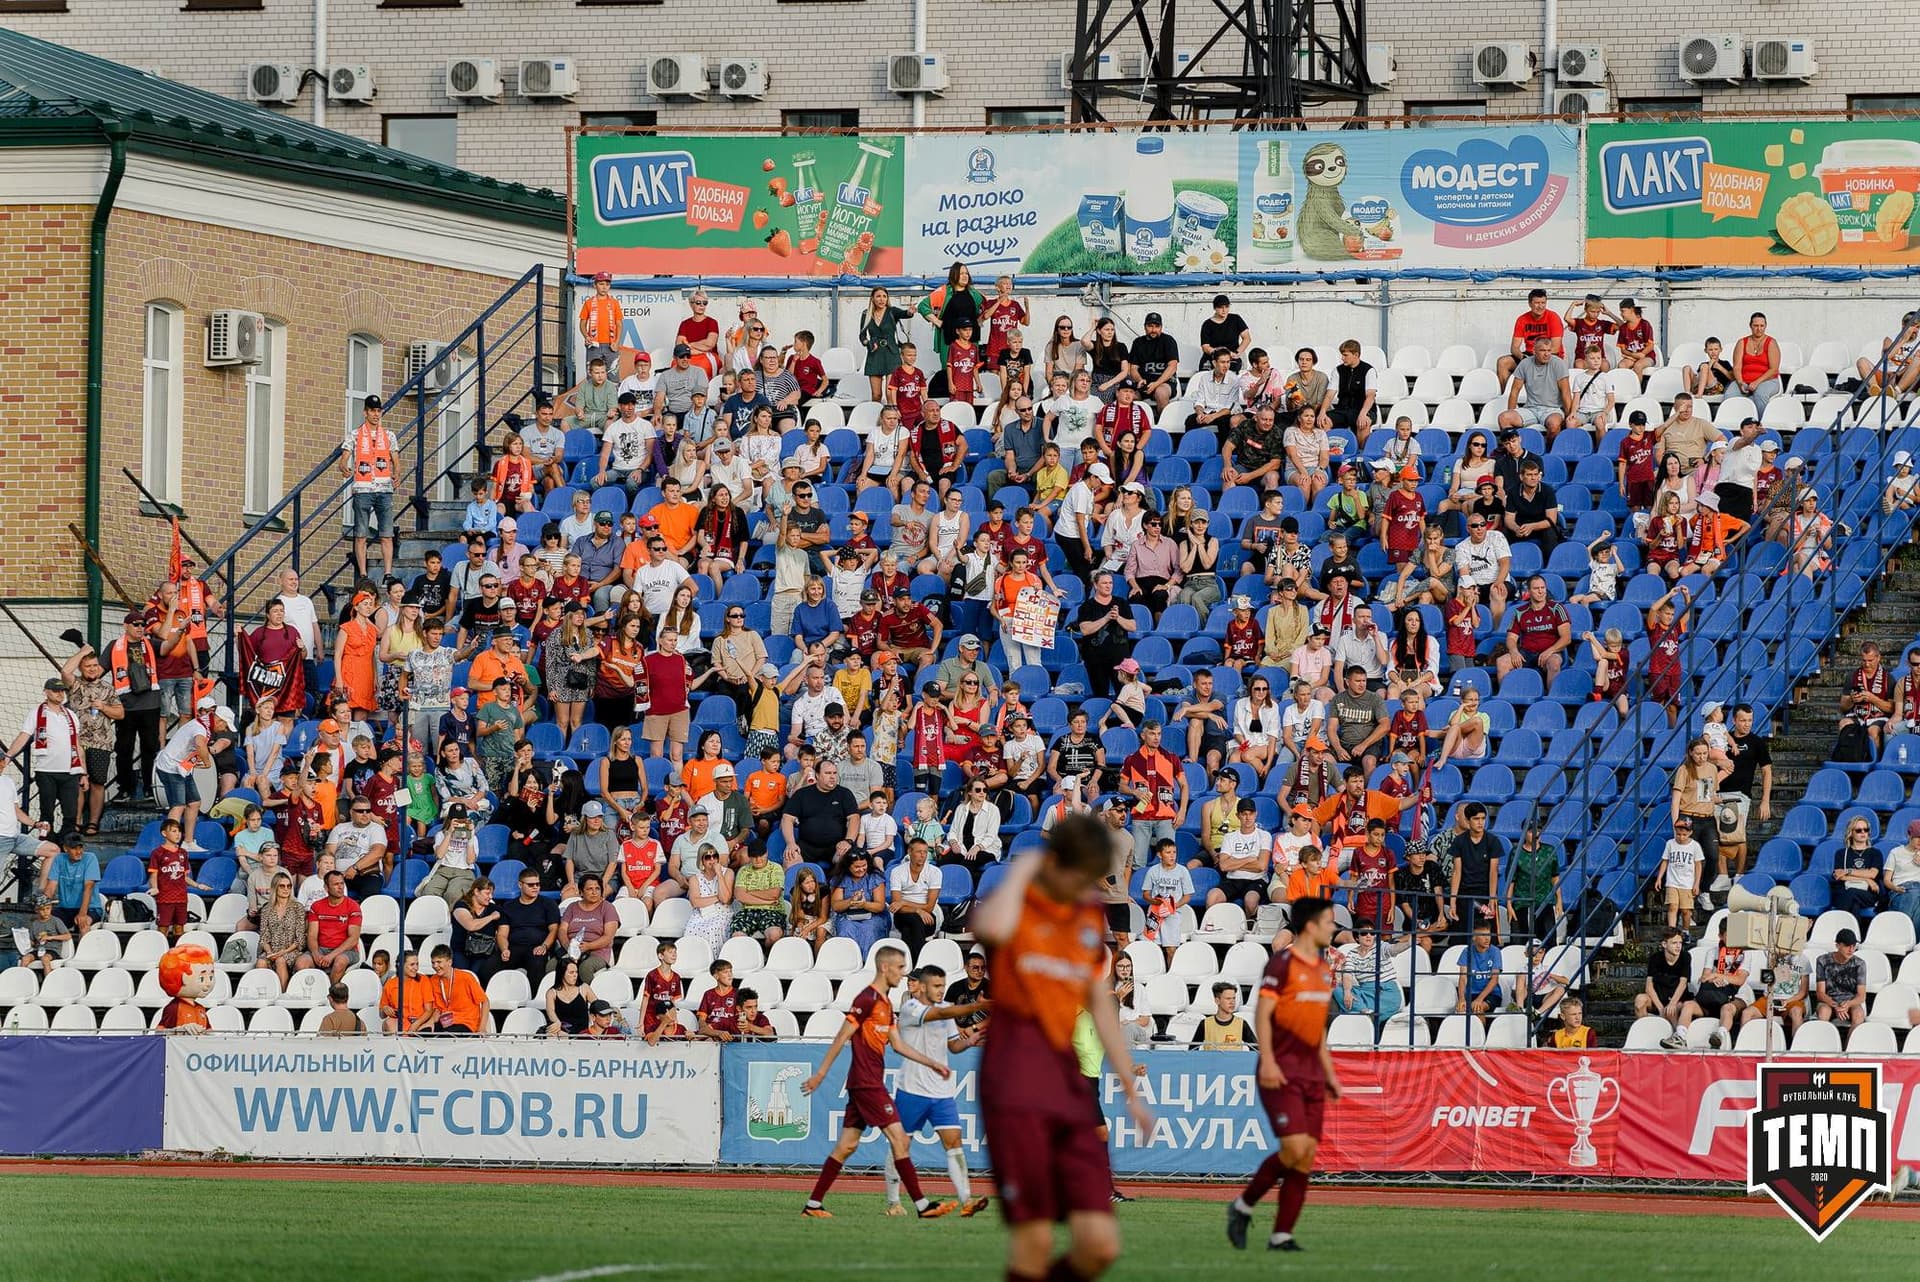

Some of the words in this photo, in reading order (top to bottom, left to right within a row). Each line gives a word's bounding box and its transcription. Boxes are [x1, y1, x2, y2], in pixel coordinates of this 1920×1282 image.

[1412, 162, 1539, 191] МОДЕСТ
[1616, 147, 1705, 199] ЛАКТ
[1709, 172, 1764, 192] УДОБНАЯ
[607, 161, 689, 211] ЛАКТ
[692, 184, 744, 206] УДОБНАЯ
[1845, 178, 1895, 191] НОВИНКА
[938, 188, 1024, 212] Молоко
[1434, 193, 1473, 201] эксперты
[1481, 193, 1514, 201] детском
[1436, 201, 1476, 209] молочном
[1707, 192, 1752, 211] ПОЛЬЗА
[691, 204, 734, 223] ПОЛЬЗА
[832, 204, 873, 231] ЙОГУРТ
[1353, 207, 1386, 215] МОДЕСТ
[1466, 233, 1473, 241] и
[1474, 224, 1518, 242] детских
[1519, 183, 1560, 230] вопросах!
[921, 220, 950, 237] на
[956, 210, 1037, 238] разные
[943, 236, 1019, 258] «хочу»
[1131, 246, 1159, 256] МОЛОКО
[627, 294, 675, 304] ТРИБУНА
[252, 665, 283, 687] ТЕМП
[1669, 851, 1694, 865] HAVE
[186, 1049, 375, 1077] ОФИЦИАЛЬНЫЙ
[383, 1049, 444, 1074] САЙТ
[451, 1056, 697, 1080] «ДИНАМО-БАРНАУЛ»
[234, 1087, 648, 1140] WWW.FCDB.RU
[1431, 1106, 1537, 1128] FONBET
